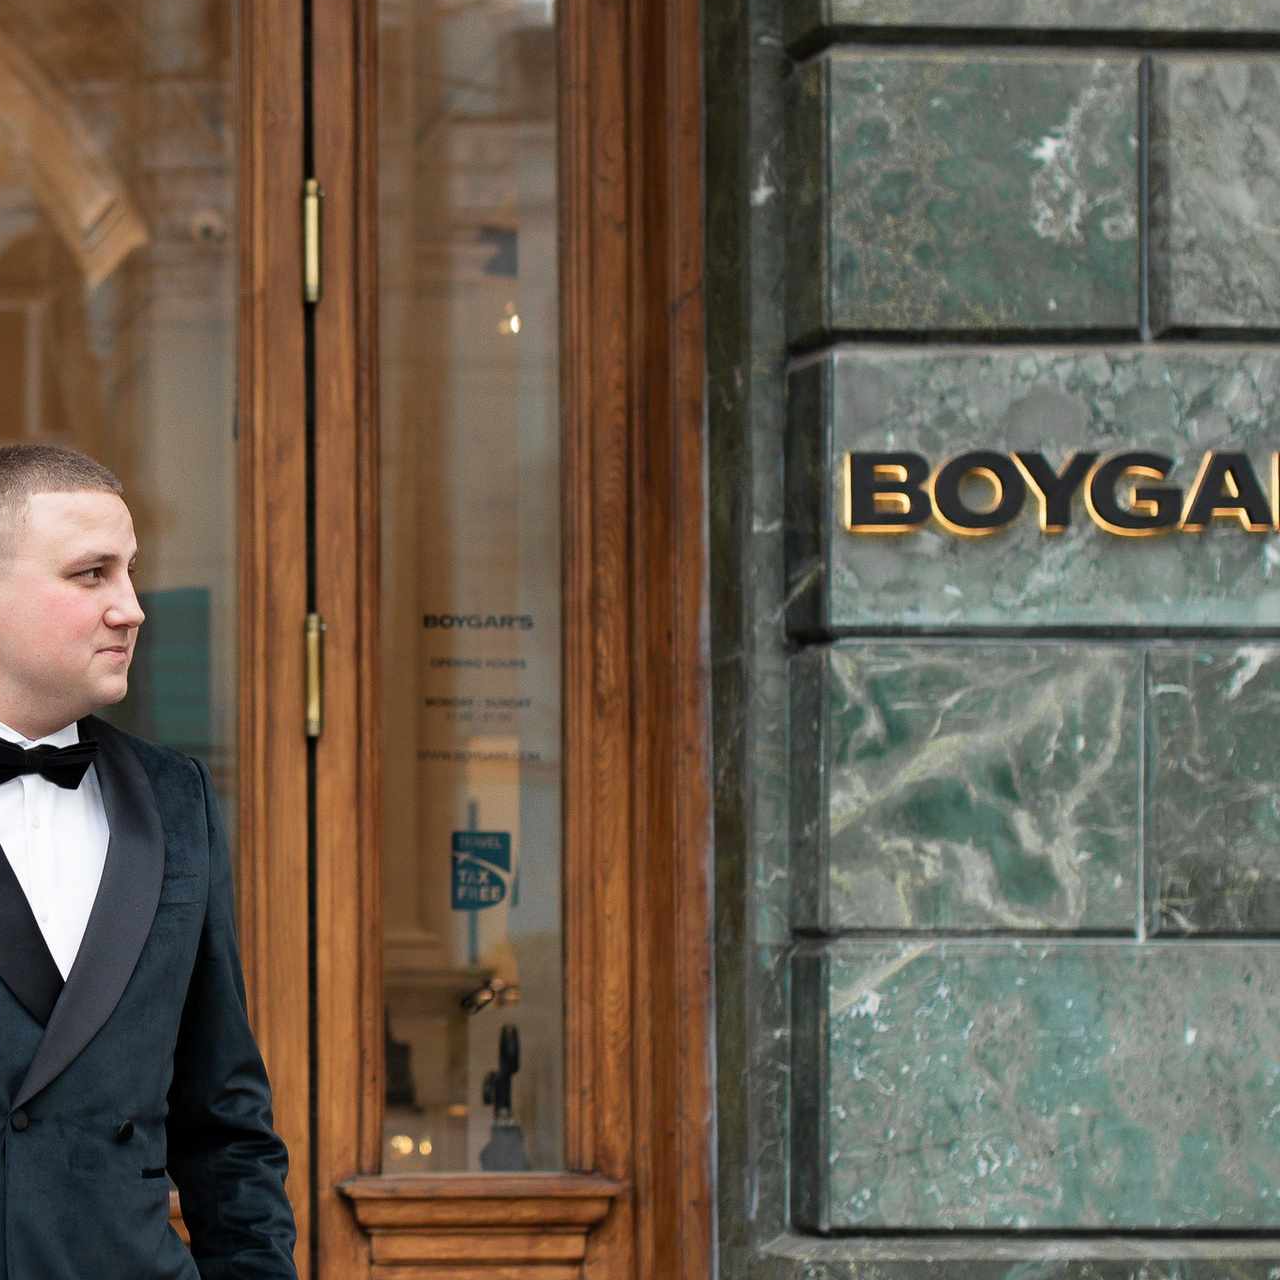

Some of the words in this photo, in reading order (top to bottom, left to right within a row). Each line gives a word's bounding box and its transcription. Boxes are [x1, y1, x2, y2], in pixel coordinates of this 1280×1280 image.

[844, 450, 1280, 536] BOYGA
[423, 613, 534, 630] BOYGAR'S
[458, 870, 489, 884] TAX
[458, 885, 501, 902] FREE
